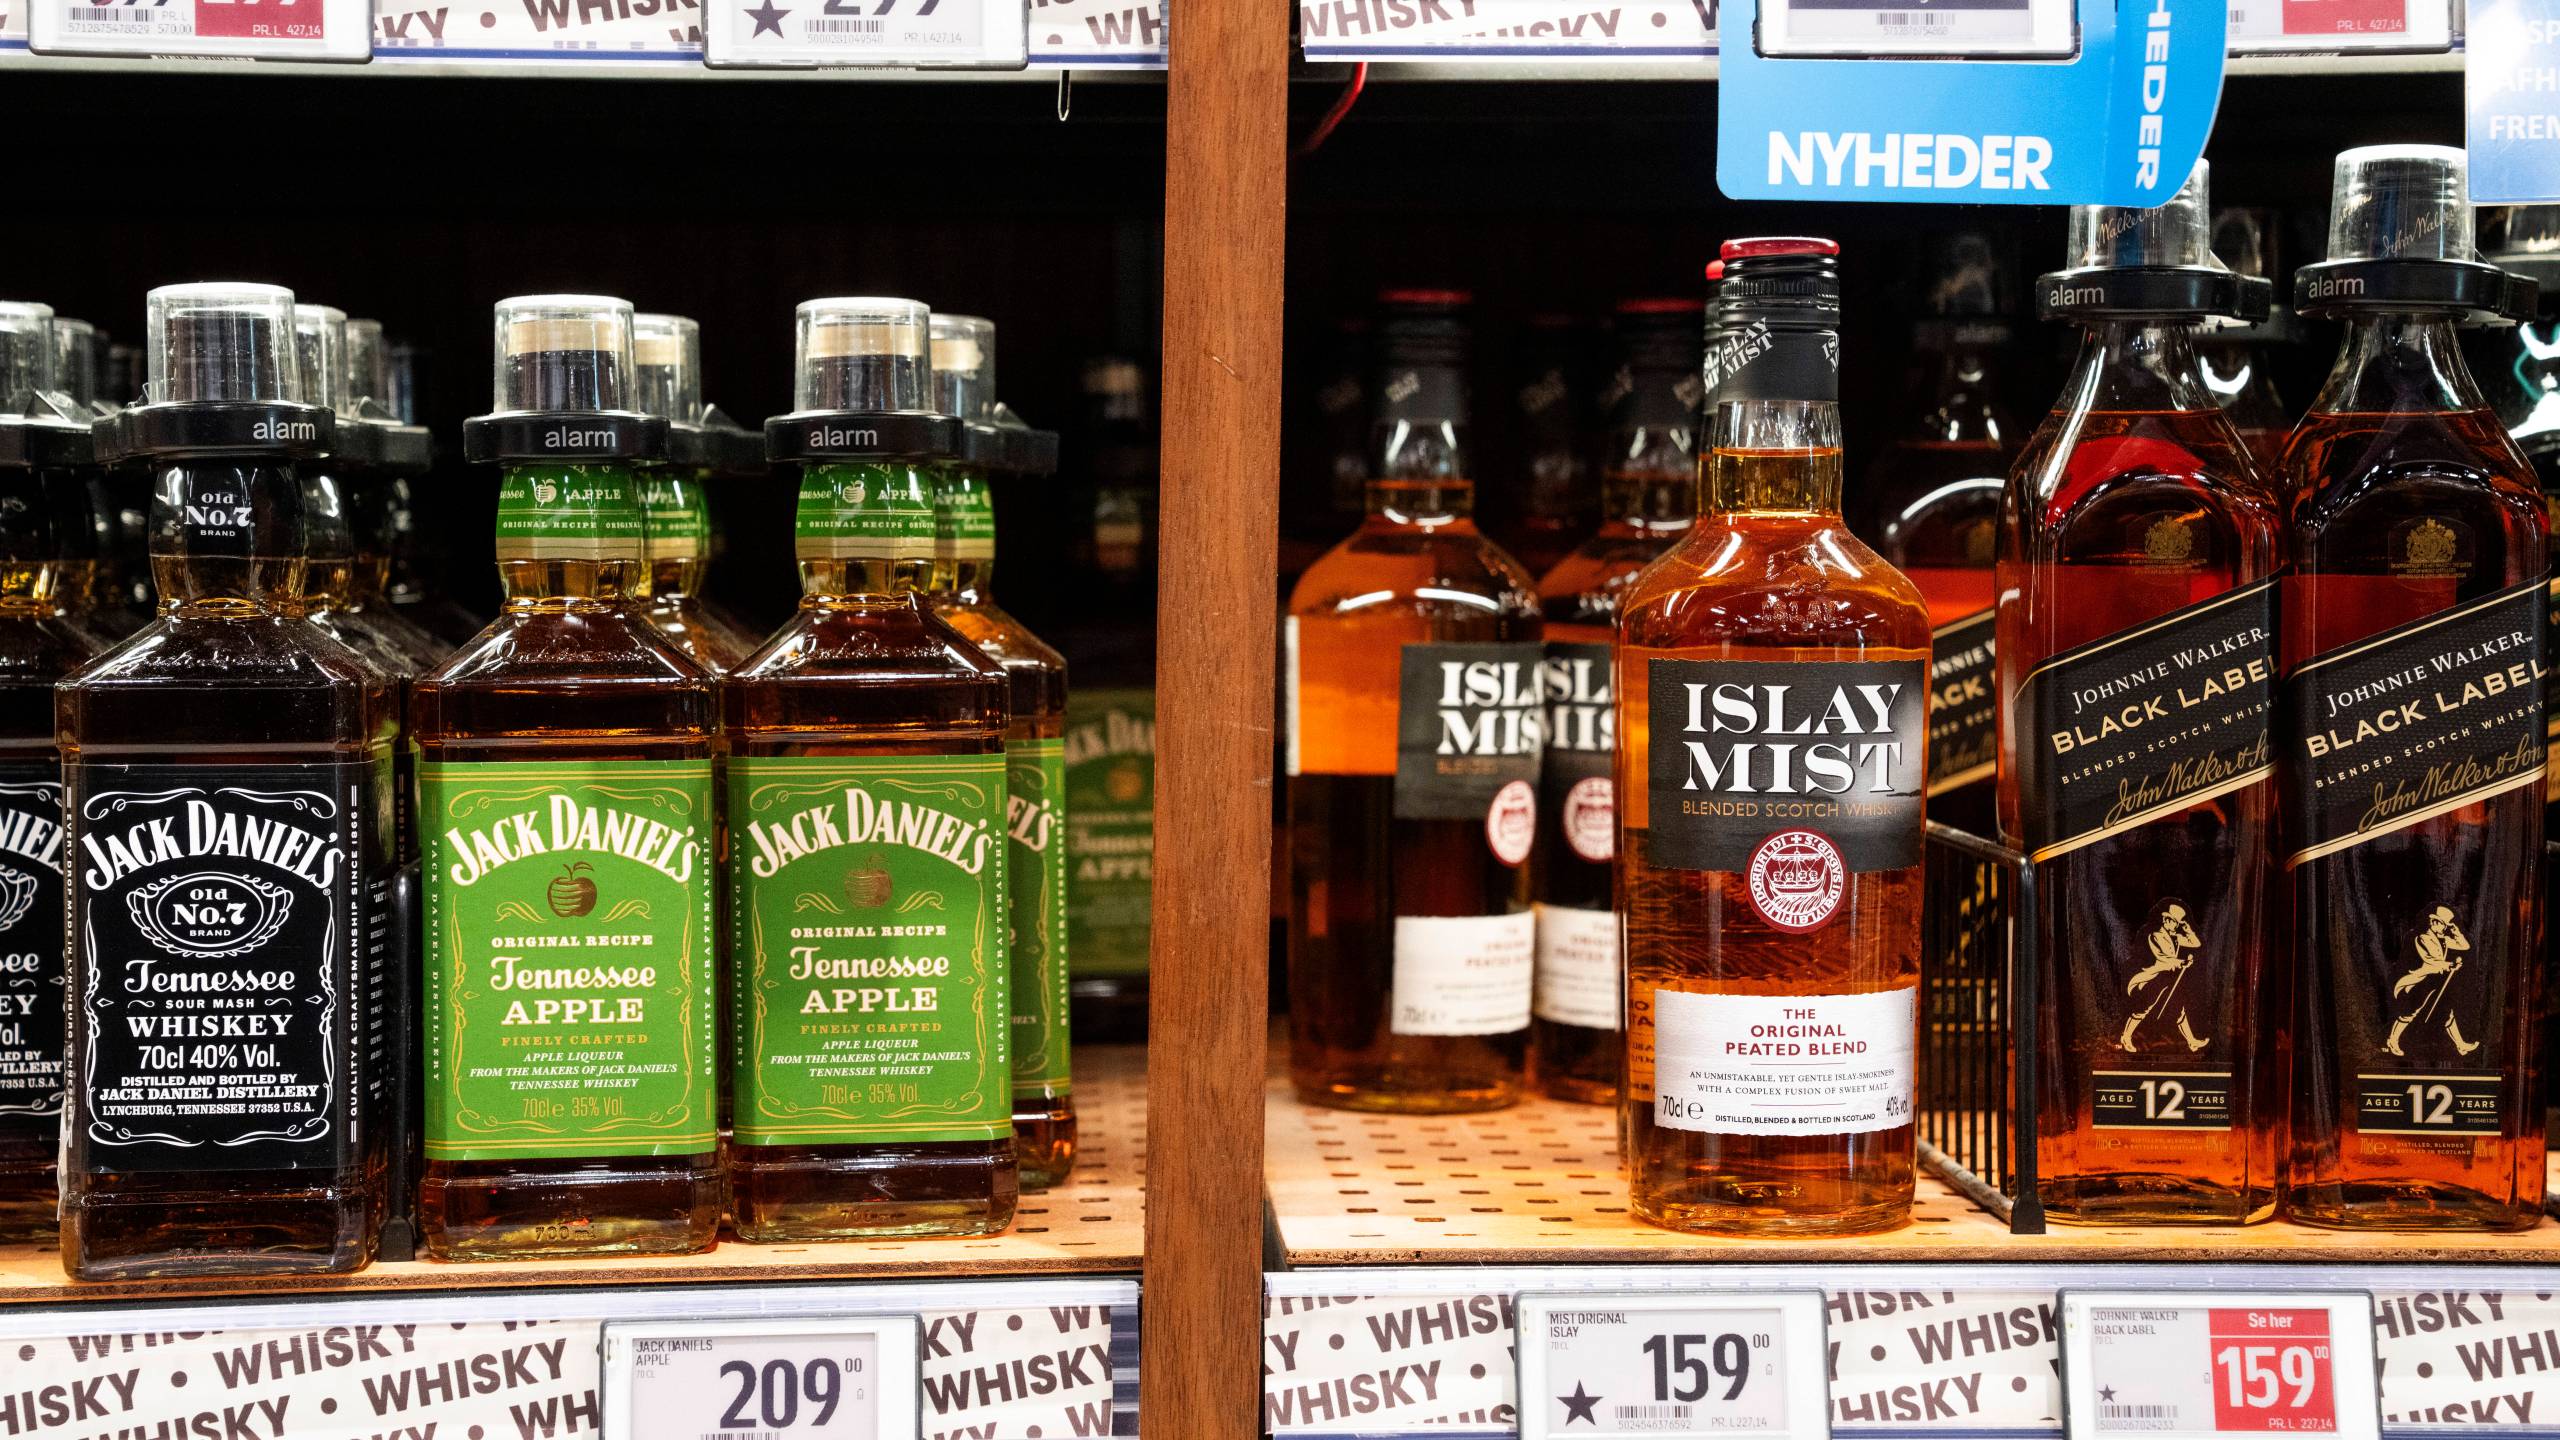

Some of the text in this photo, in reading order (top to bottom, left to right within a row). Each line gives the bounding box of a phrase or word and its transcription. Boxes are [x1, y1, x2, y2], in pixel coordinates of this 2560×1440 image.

[252, 24, 321, 37] PR. L 427,14
[2337, 20, 2355, 31] PR.
[2370, 19, 2403, 31] 427,14
[1768, 131, 2053, 190] NYHEDER
[2050, 284, 2105, 307] alarm
[2309, 276, 2365, 298] alarm
[252, 418, 316, 440] alarm
[545, 425, 616, 447] alarm
[809, 425, 878, 447] alarm
[201, 492, 234, 504] Old
[184, 505, 253, 527] No.7
[200, 529, 236, 537] BRAND
[2071, 662, 2170, 714] JOHNNIE
[2326, 665, 2428, 718] JOHNNIE
[1682, 683, 1903, 735] ISLAY
[2305, 657, 2550, 758] BLACK LABEL
[2051, 695, 2169, 755] BLACK
[2061, 695, 2278, 785] BLENDED SCOTCH WHISK
[2315, 699, 2546, 789] BLENDED SCOTCH WHISKY
[1681, 741, 1903, 794] MIST
[1682, 800, 1759, 818] BLENDED
[1765, 802, 1840, 818] SCOTCH
[444, 810, 550, 887] JACK
[747, 803, 845, 878] JACK
[80, 815, 185, 891] JACK
[189, 888, 229, 901] Old
[171, 902, 247, 926] No.7
[189, 929, 232, 937] BRAND
[491, 934, 654, 948] ORIGINAL RECIPE
[790, 925, 947, 939] ORIGINAL RECIPE
[490, 955, 656, 990] Tennessee
[789, 946, 950, 980] Tennessee
[124, 959, 296, 993] Tennessee
[165, 998, 255, 1009] SOUR MASH
[501, 997, 645, 1026] APPLE
[800, 987, 938, 1014] APPLE
[1782, 1008, 1817, 1020] THE
[126, 1014, 294, 1038] WHISKEY
[800, 1022, 943, 1035] FINELY CRAFTED
[1750, 1023, 1847, 1038] ORIGINAL
[502, 1034, 648, 1047] FINELY CRAFTED
[822, 1039, 919, 1050] APPLE LIQUEUR
[1725, 1040, 1868, 1056] PEATED BLEND
[138, 1043, 281, 1069] 70cl 40% Vol.
[523, 1051, 624, 1062] APPLE LIQUEUR
[121, 1073, 298, 1087] DISTILLED AND BOTTLED BY
[470, 1067, 503, 1078] FROM
[505, 1067, 529, 1077] THE
[531, 1066, 580, 1076] MAKERS
[581, 1065, 597, 1075] OF
[597, 1064, 626, 1077] JACK
[808, 1066, 933, 1078] TENNESSEE WHISKEY
[1689, 1071, 1702, 1079] AN
[1704, 1072, 1776, 1083] UNMISTAKABLE,
[1779, 1074, 1796, 1083] YET
[1797, 1074, 1833, 1083] GENTLE
[99, 1084, 320, 1101] JACK DANIEL DISTILLERY
[509, 1078, 640, 1091] TENNESSEE WHISKEY
[1697, 1084, 1722, 1094] WITH
[1725, 1086, 1732, 1094] A
[1735, 1086, 1782, 1096] COMPLEX
[1785, 1087, 1822, 1096] FUSION
[1824, 1086, 1837, 1095] OF
[1839, 1085, 1866, 1094] SWEET
[102, 1101, 315, 1117] LYNCHBURG, TENNESSEE 37352 U.S.A.
[523, 1098, 549, 1118] 70cl
[571, 1097, 599, 1118] 35%
[603, 1096, 626, 1116] Vol.
[1662, 1095, 1684, 1118] 70cl
[2100, 1079, 2226, 1120] AGED 12 YEARS
[2366, 1084, 2496, 1124] AGED 12 YEARS
[1715, 1113, 1876, 1125] DISTILLED, BLENDED & BOTTLED IN SCOTLAND
[1550, 1312, 1628, 1325] MIST ORIGINAL
[2093, 1310, 2178, 1321] JOHNNIE WALKER
[2248, 1312, 2294, 1328] Se her
[1550, 1326, 1579, 1338] ISLAY
[2094, 1324, 2157, 1335] BLACK LABEL
[213, 1322, 417, 1390] WHISKY
[636, 1338, 713, 1353] JACK DANIELS
[636, 1354, 671, 1367] APPLE
[1643, 1333, 1770, 1402] 159 00
[362, 1337, 567, 1417] WHISKY
[922, 1340, 1113, 1415] WHISKY
[2217, 1345, 2329, 1408] 159 00
[719, 1357, 863, 1429] 209 00
[2268, 1418, 2333, 1430] PR. L 227,14
